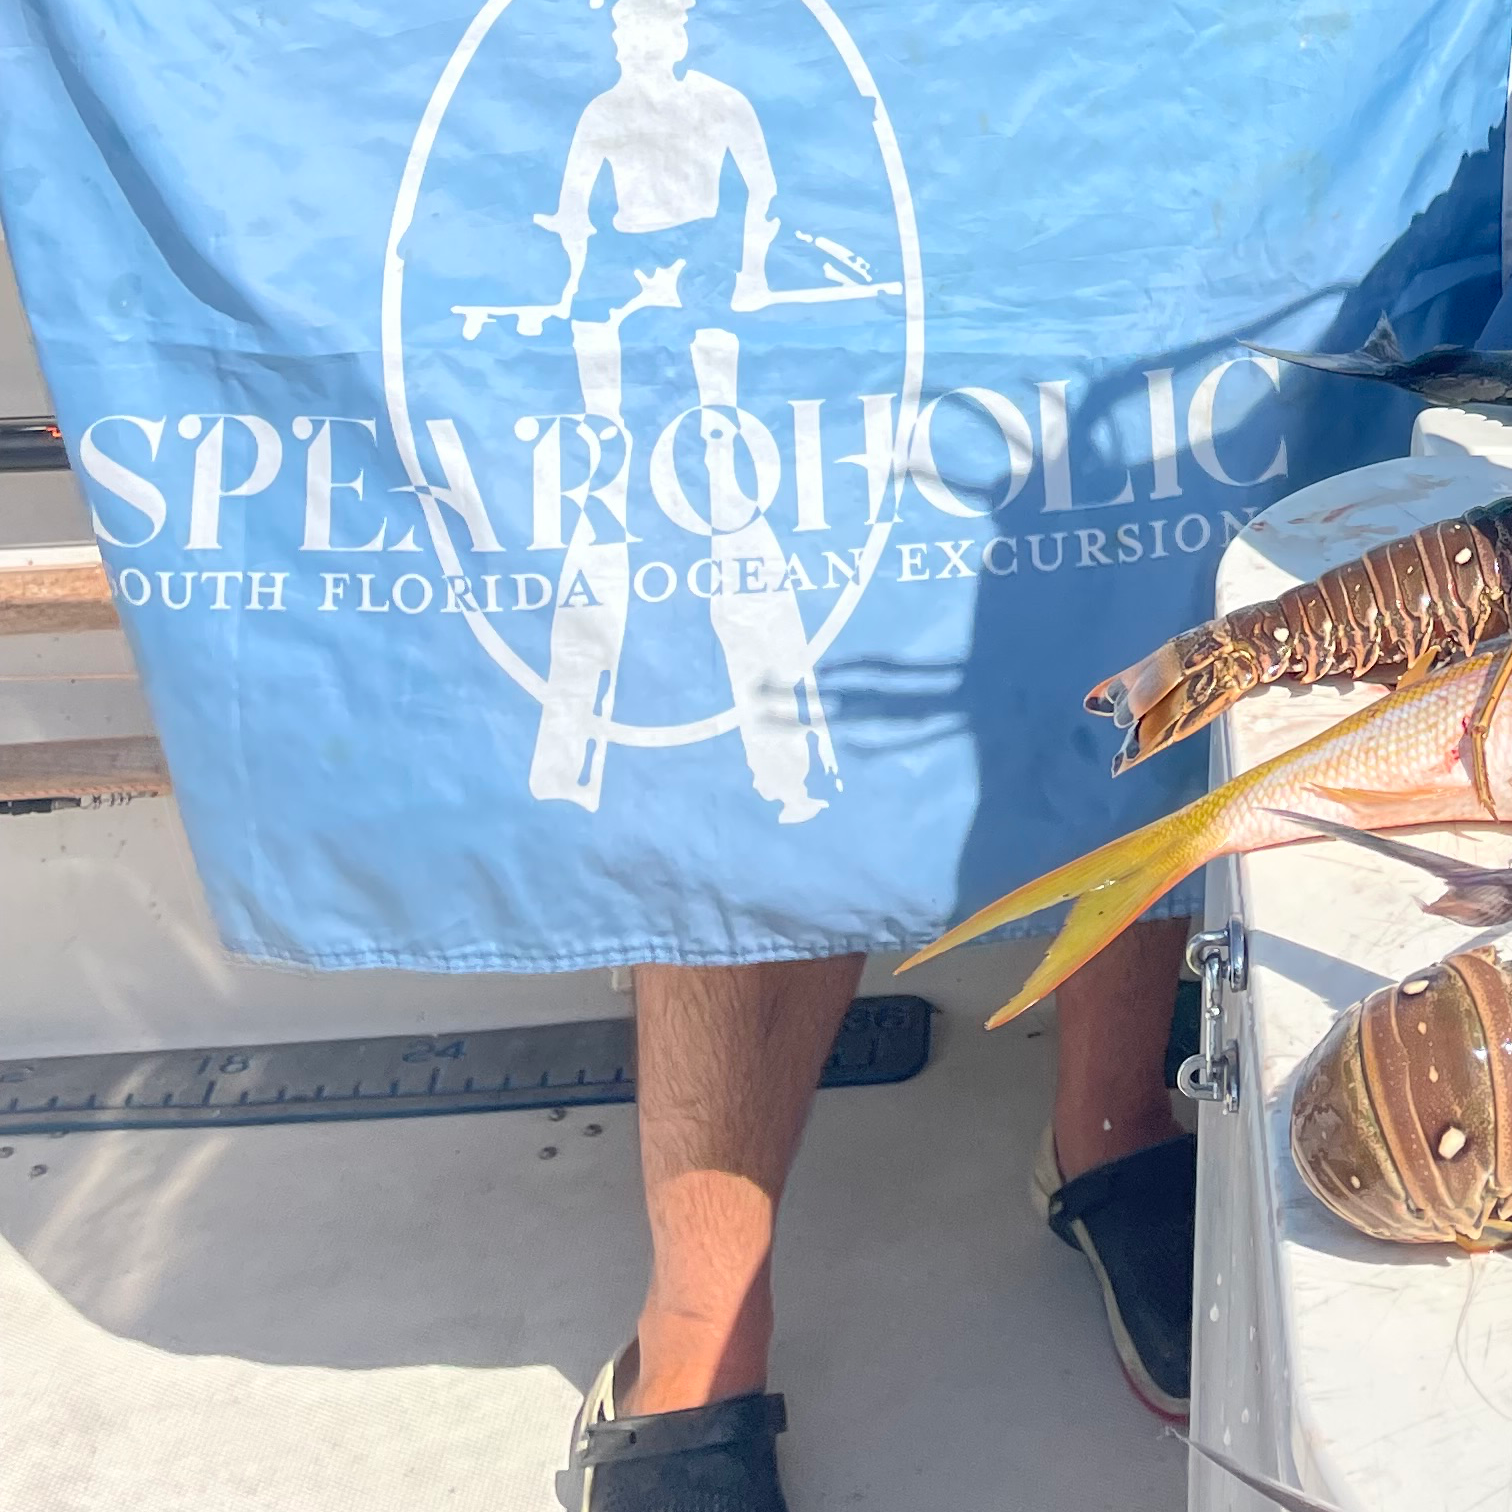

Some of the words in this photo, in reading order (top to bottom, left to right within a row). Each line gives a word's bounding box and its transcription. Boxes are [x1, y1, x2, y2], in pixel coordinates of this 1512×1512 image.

[80, 356, 1289, 552] SPEAROHOLIC
[112, 567, 290, 612] OUTH
[317, 569, 605, 615] FLORIDA
[634, 548, 863, 603] OCEAN
[198, 1053, 250, 1075] 18
[402, 1039, 466, 1063] 24
